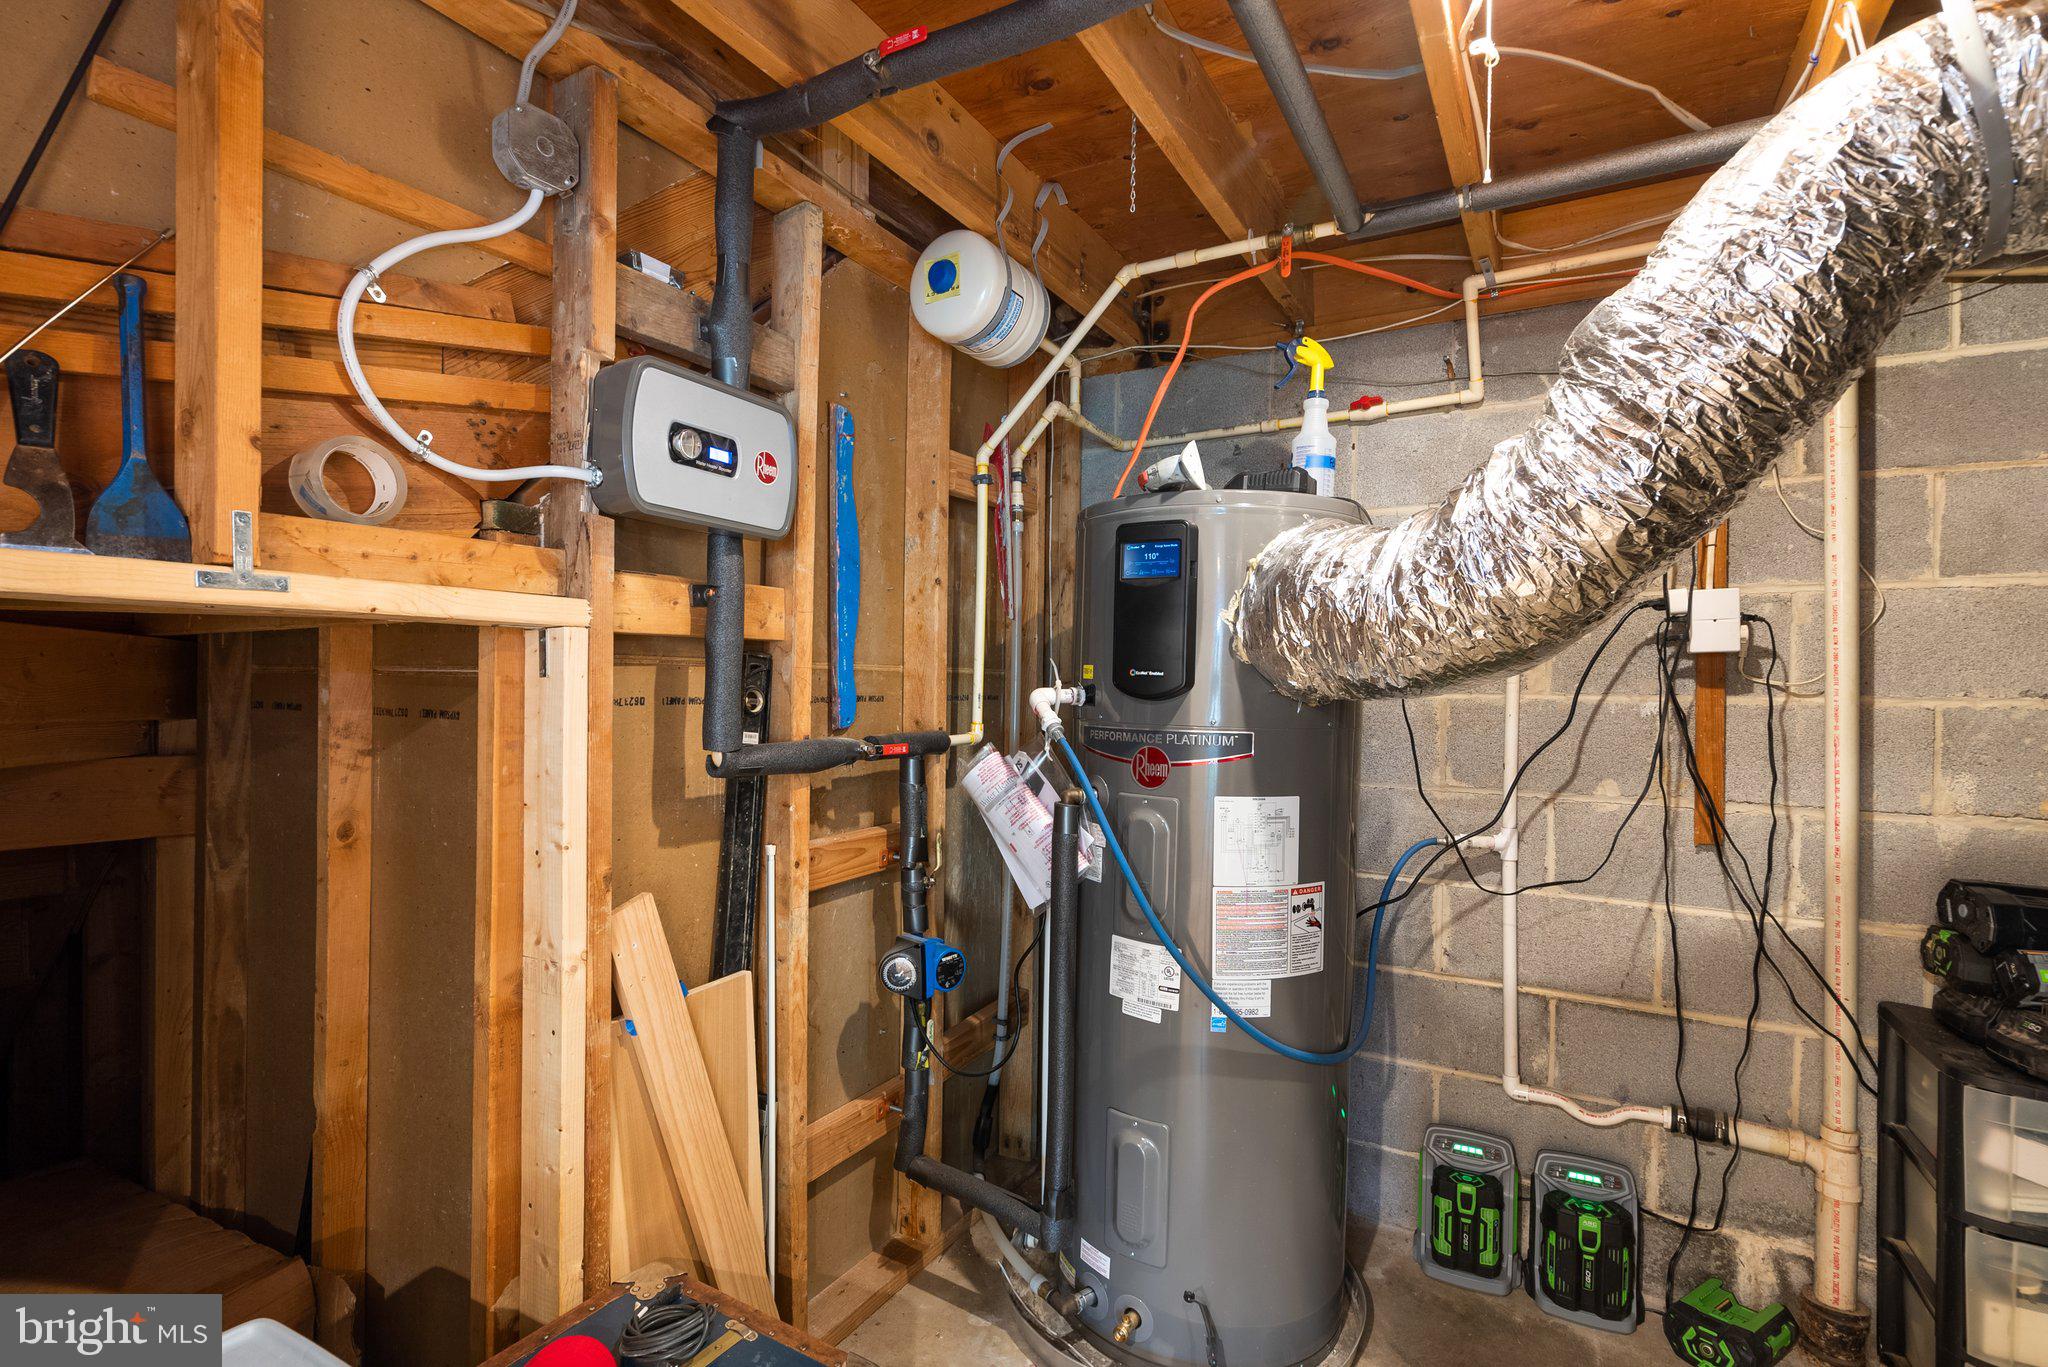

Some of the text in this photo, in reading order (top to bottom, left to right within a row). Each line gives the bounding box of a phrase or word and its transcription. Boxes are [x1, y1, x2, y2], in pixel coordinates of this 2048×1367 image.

[757, 451, 777, 479] Rheem
[1089, 730, 1163, 744] PERFORMANCE
[1135, 746, 1169, 782] Rheem
[1298, 885, 1322, 895] DANGER
[2023, 1020, 2042, 1033] EGO
